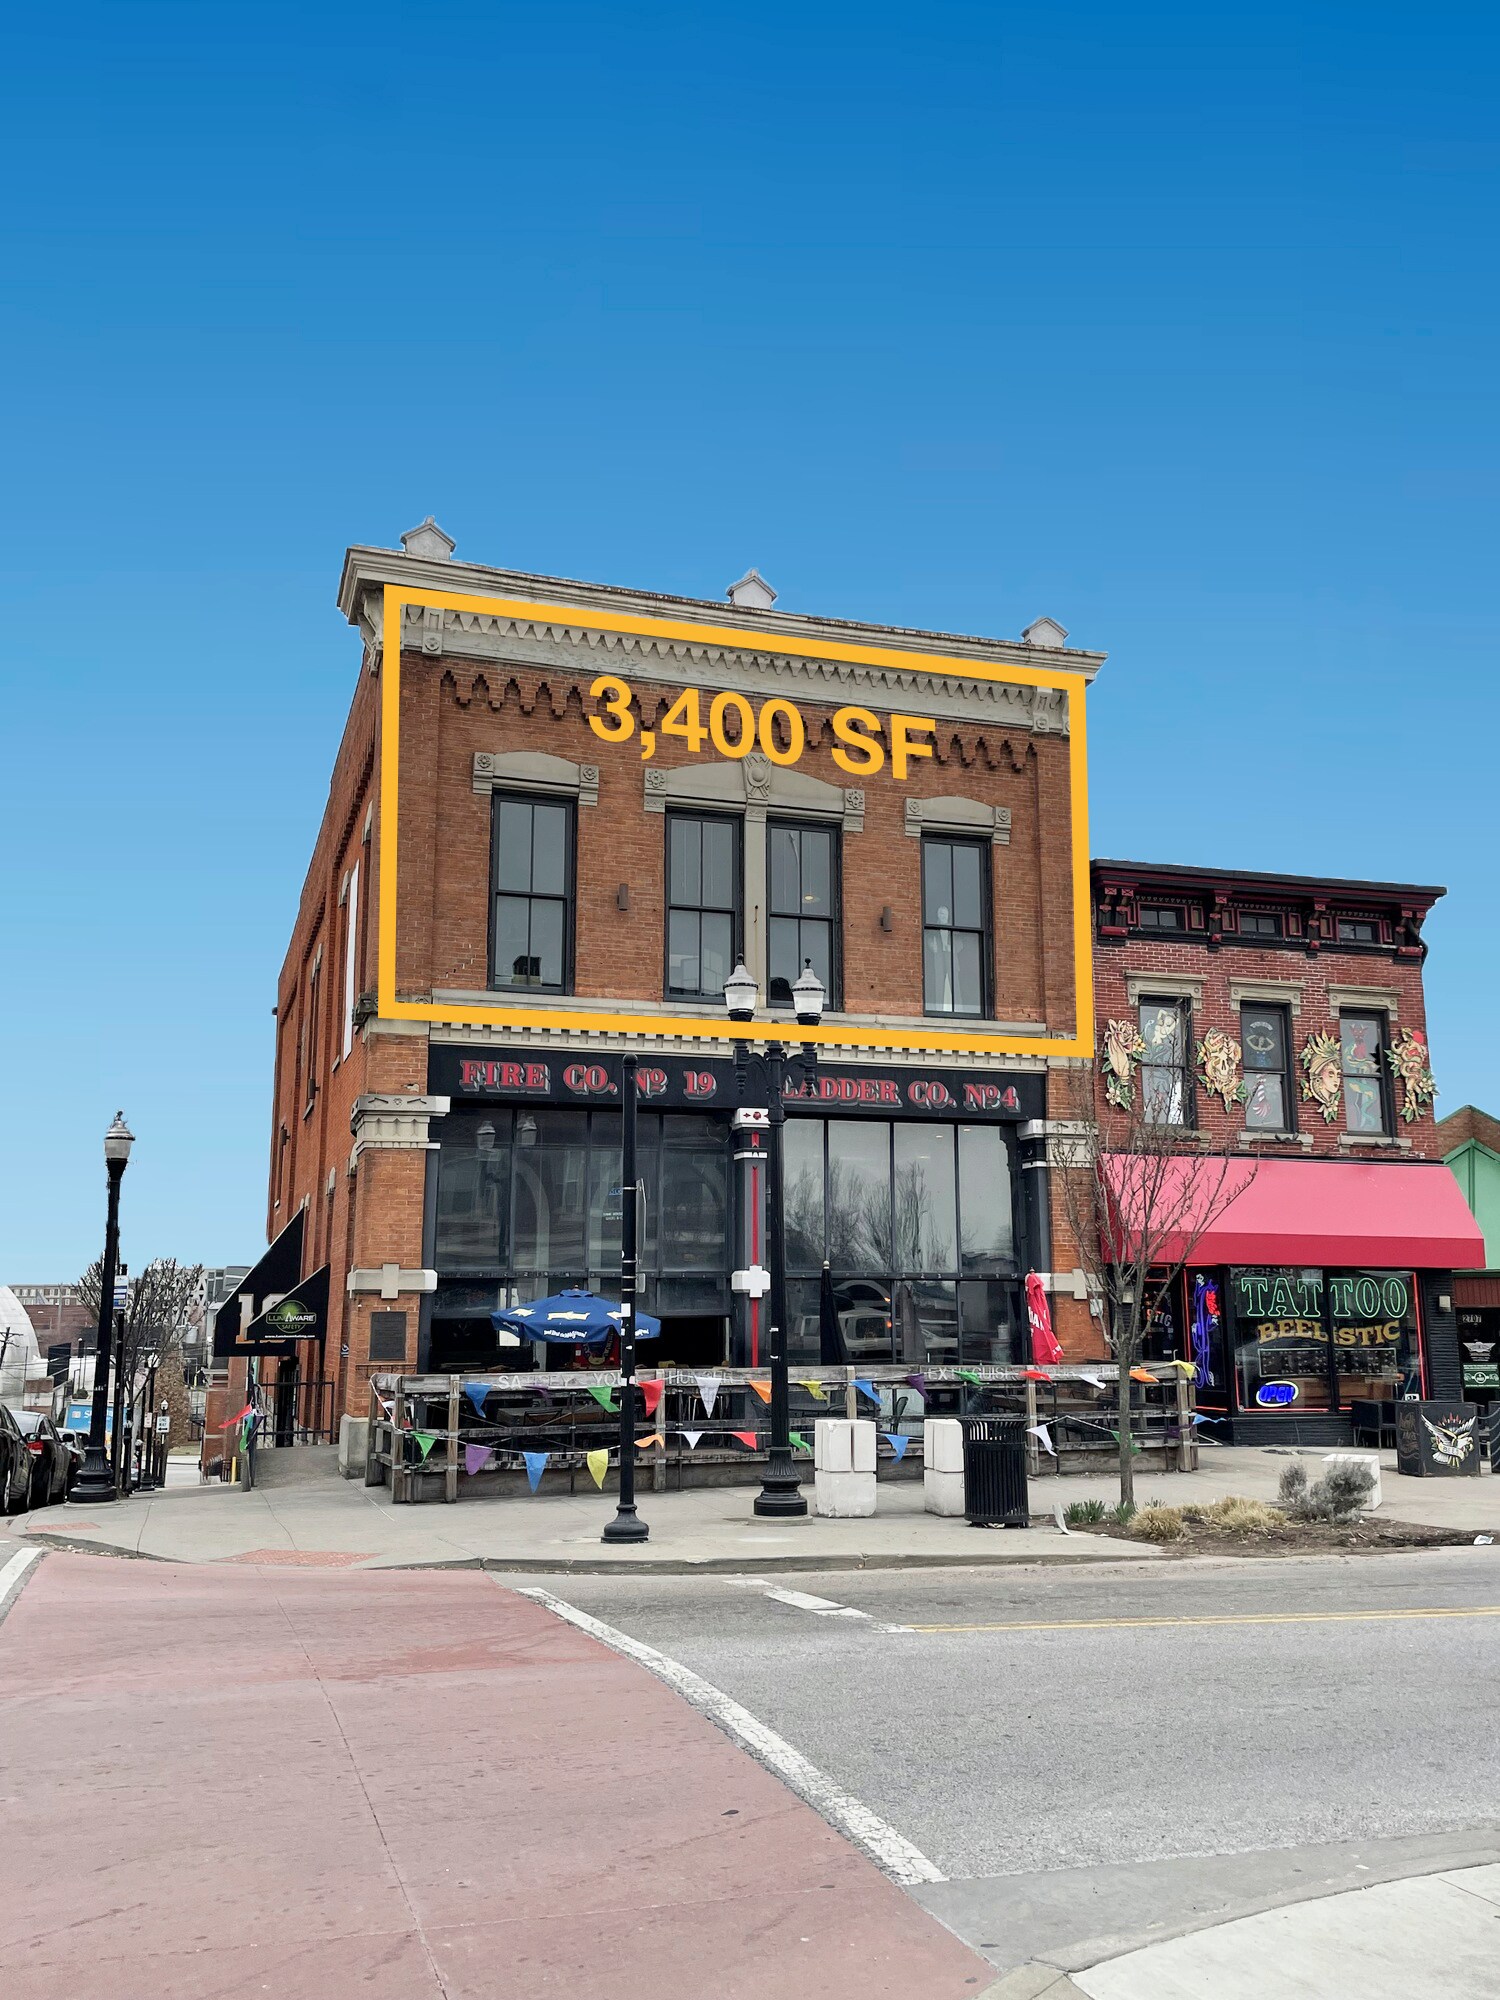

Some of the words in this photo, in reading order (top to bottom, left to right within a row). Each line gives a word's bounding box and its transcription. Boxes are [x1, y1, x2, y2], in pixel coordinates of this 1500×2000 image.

[460, 1060, 550, 1093] FIRE
[563, 1064, 617, 1094] CO.
[684, 1071, 717, 1099] 19
[781, 1075, 902, 1107] LADDER
[908, 1080, 957, 1109] CO.
[1241, 1277, 1408, 1318] TATTOO
[1258, 1385, 1295, 1403] OPEN
